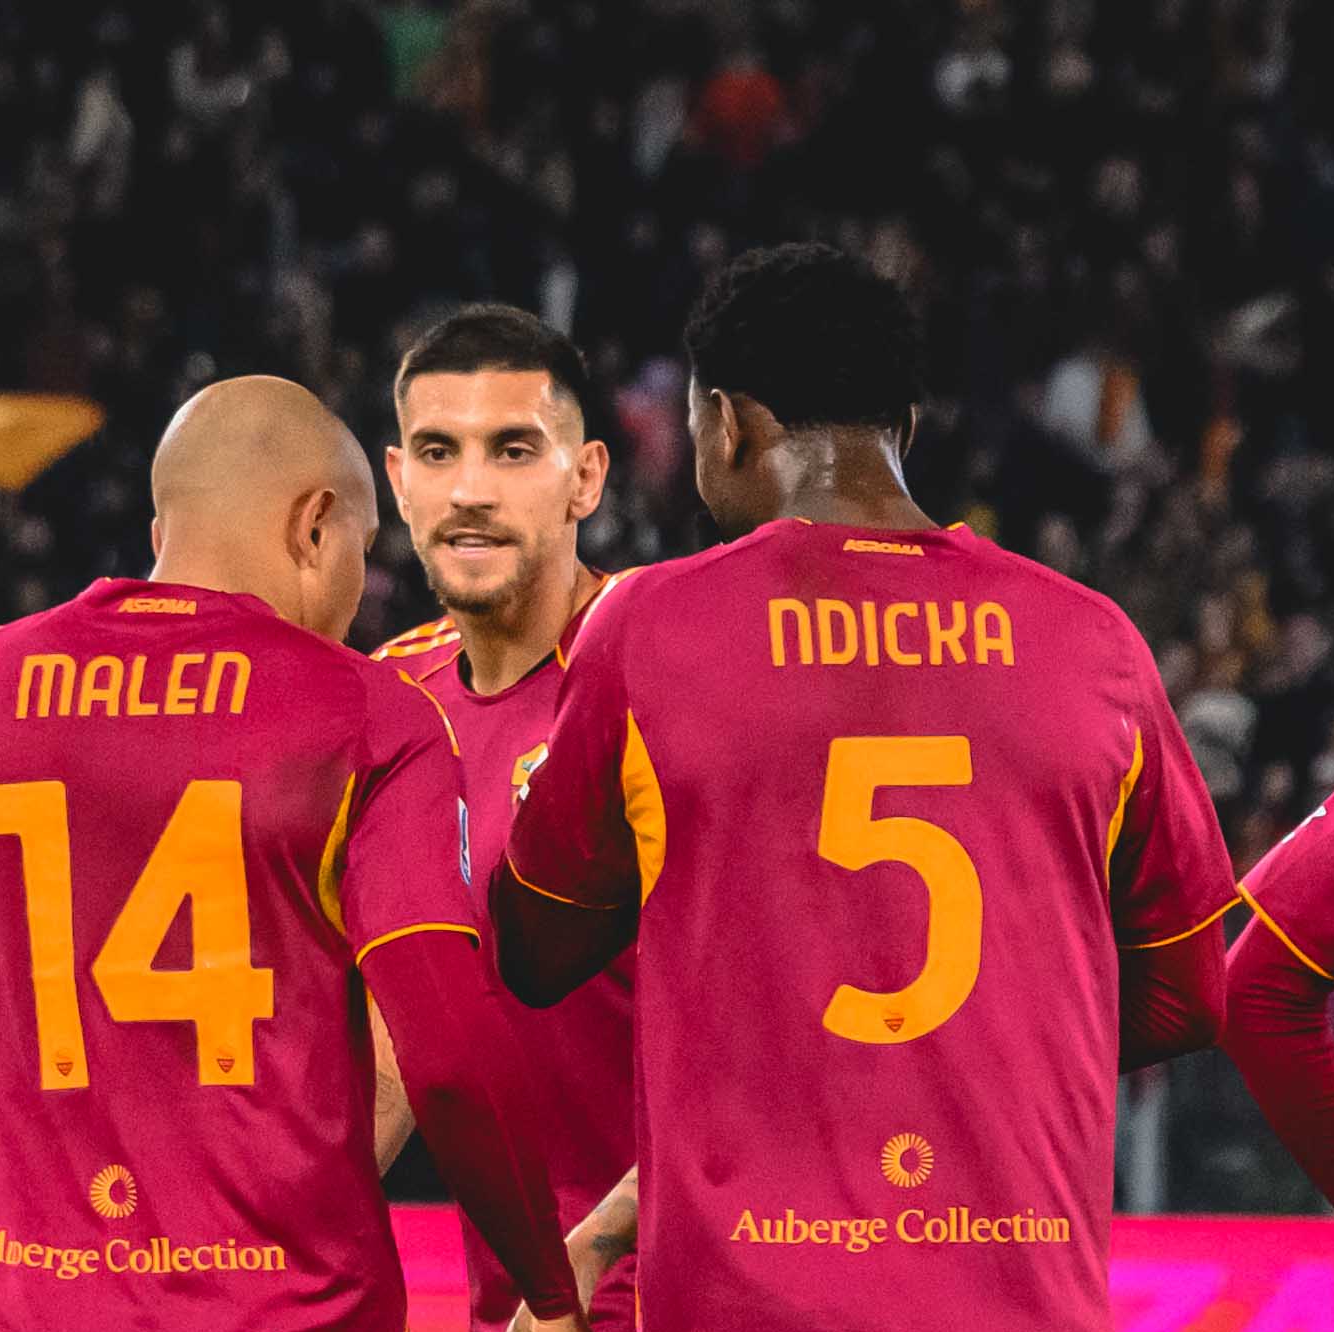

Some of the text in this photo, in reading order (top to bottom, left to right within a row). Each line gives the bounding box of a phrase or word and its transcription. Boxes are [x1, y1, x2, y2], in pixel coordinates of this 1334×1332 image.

[768, 597, 1015, 668] NDICKA
[15, 650, 252, 720] MALEN
[817, 734, 984, 1046] 5
[104, 1235, 288, 1275] Collection
[728, 1206, 1071, 1254] Auberge Collection
